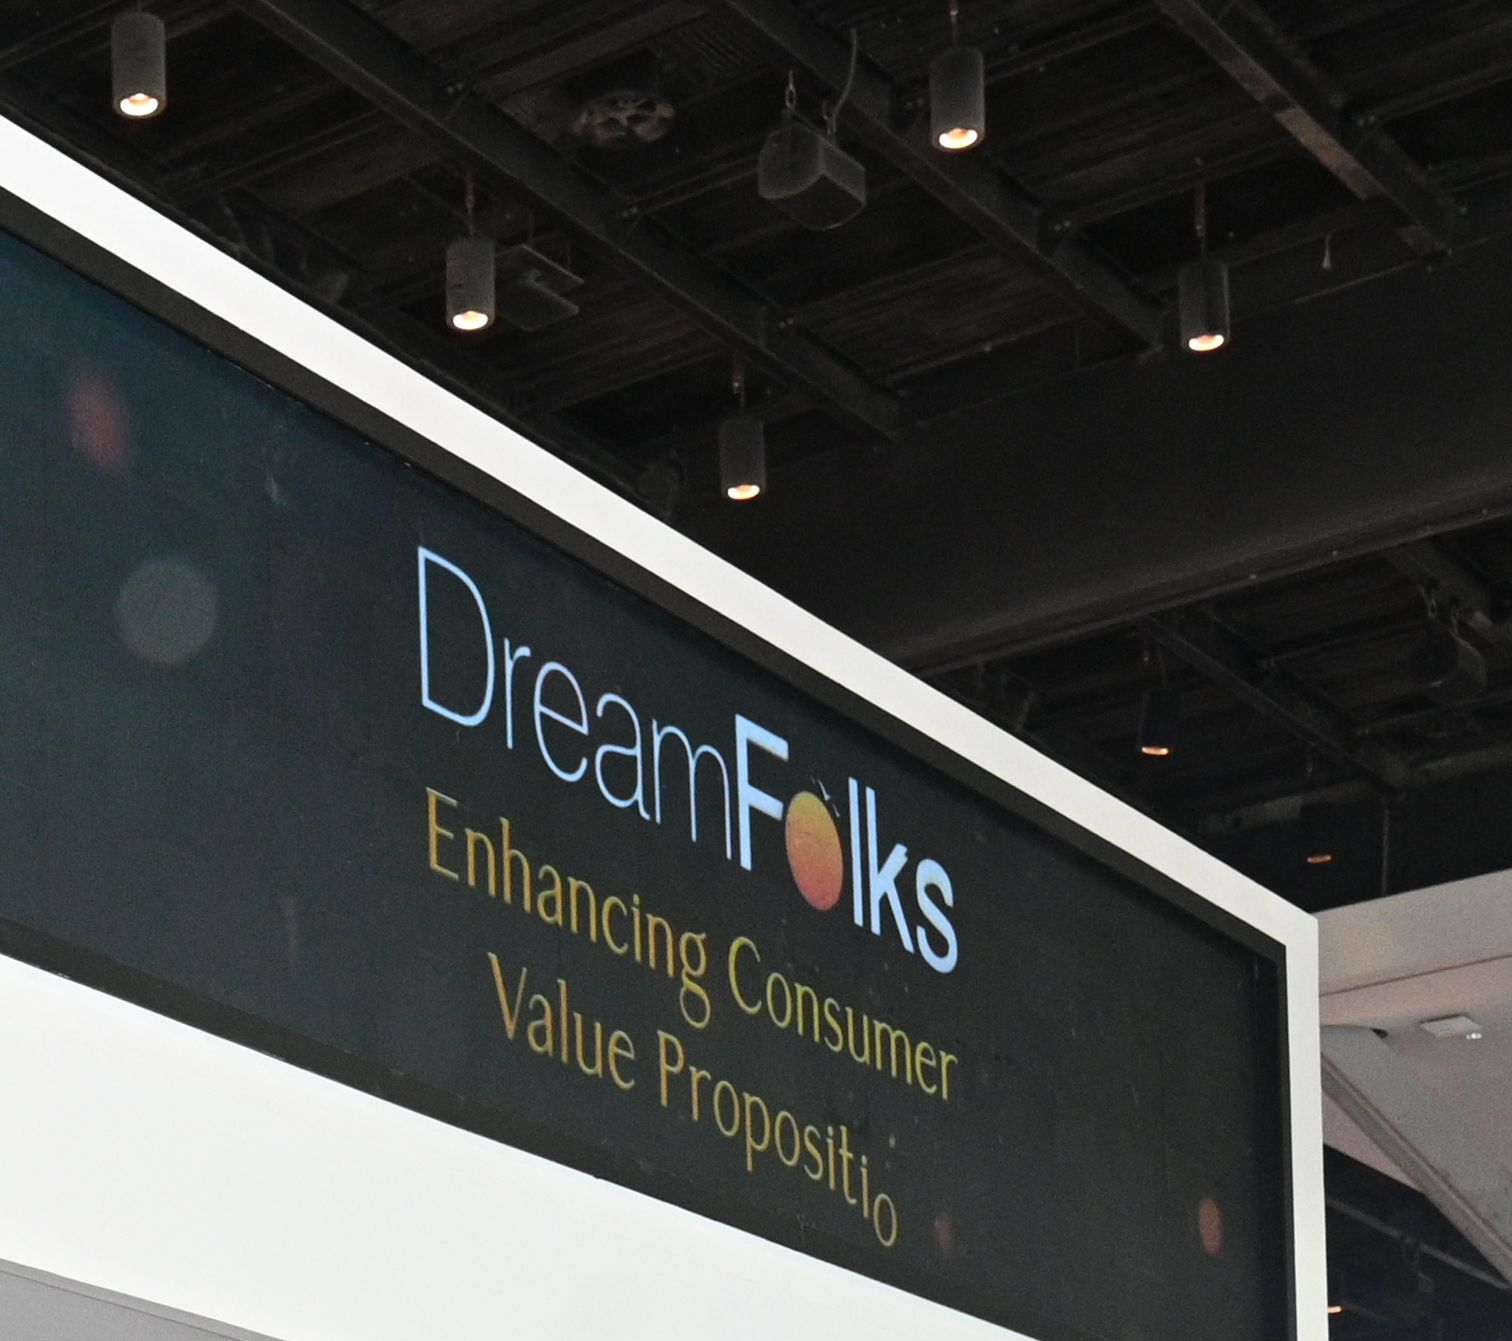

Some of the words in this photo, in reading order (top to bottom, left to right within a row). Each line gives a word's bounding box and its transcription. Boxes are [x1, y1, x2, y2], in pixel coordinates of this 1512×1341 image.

[418, 546, 959, 975] DreamFolks
[426, 787, 711, 1029] Enhancing
[728, 937, 959, 1101] Consumer
[488, 951, 636, 1091] Value
[658, 1029, 899, 1248] Propositio
